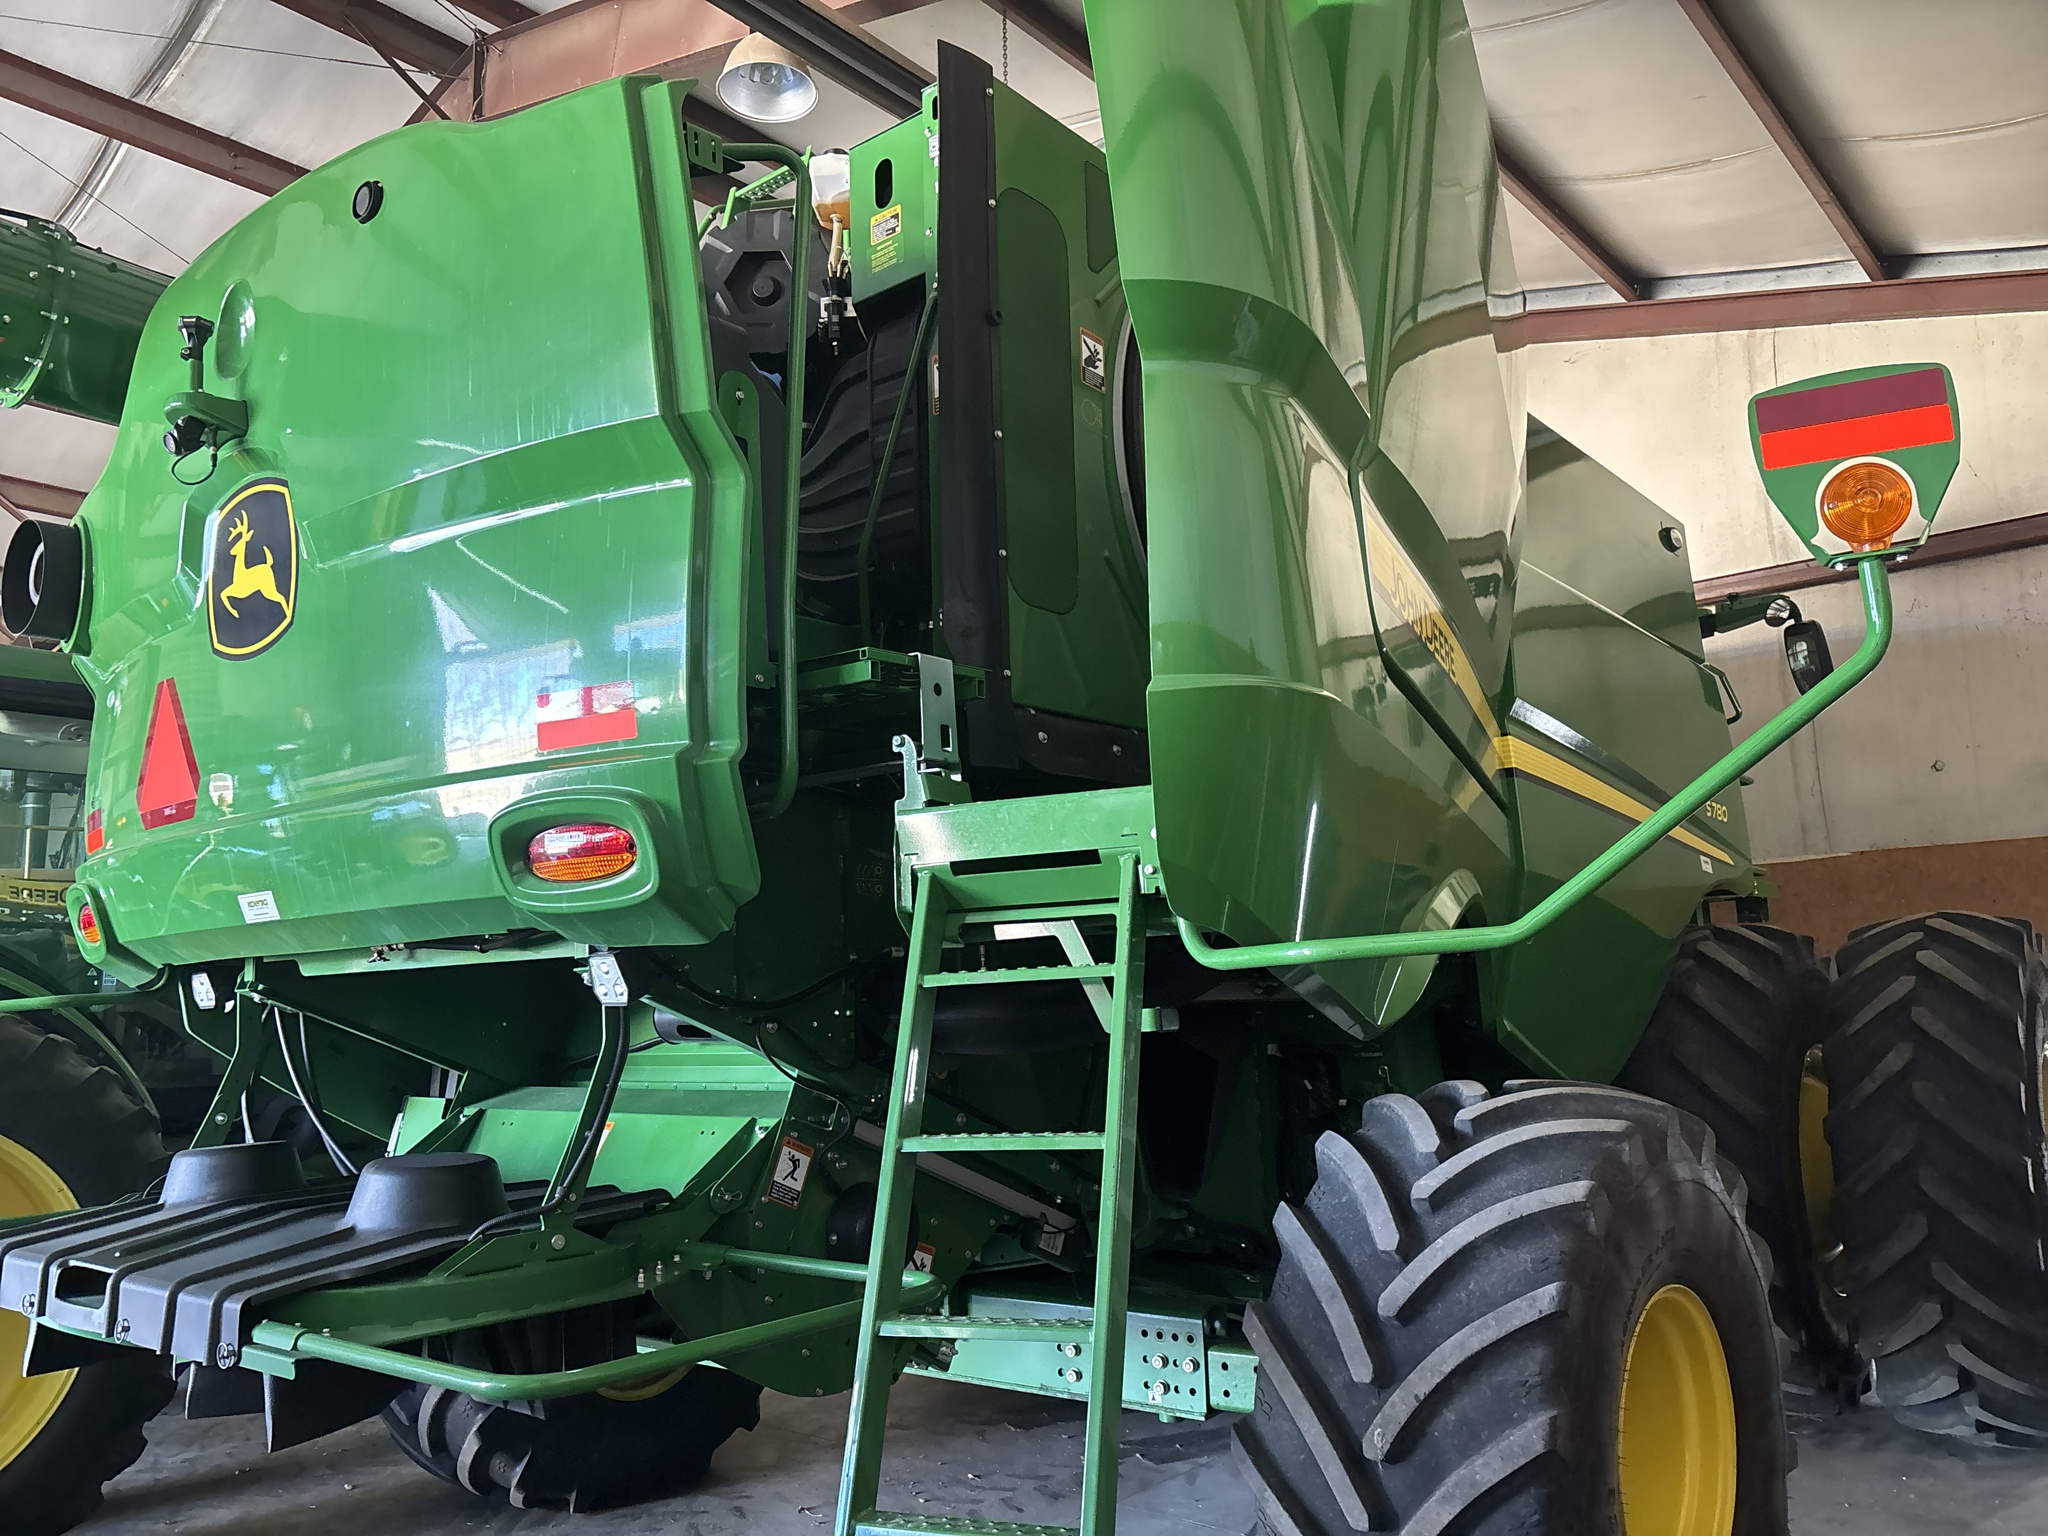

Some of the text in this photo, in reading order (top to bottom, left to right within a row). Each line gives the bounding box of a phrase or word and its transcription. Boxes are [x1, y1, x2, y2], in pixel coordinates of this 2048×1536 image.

[879, 208, 898, 220] CAUTION
[1390, 556, 1456, 679] JOHN DEERE
[1706, 801, 1728, 823] S780
